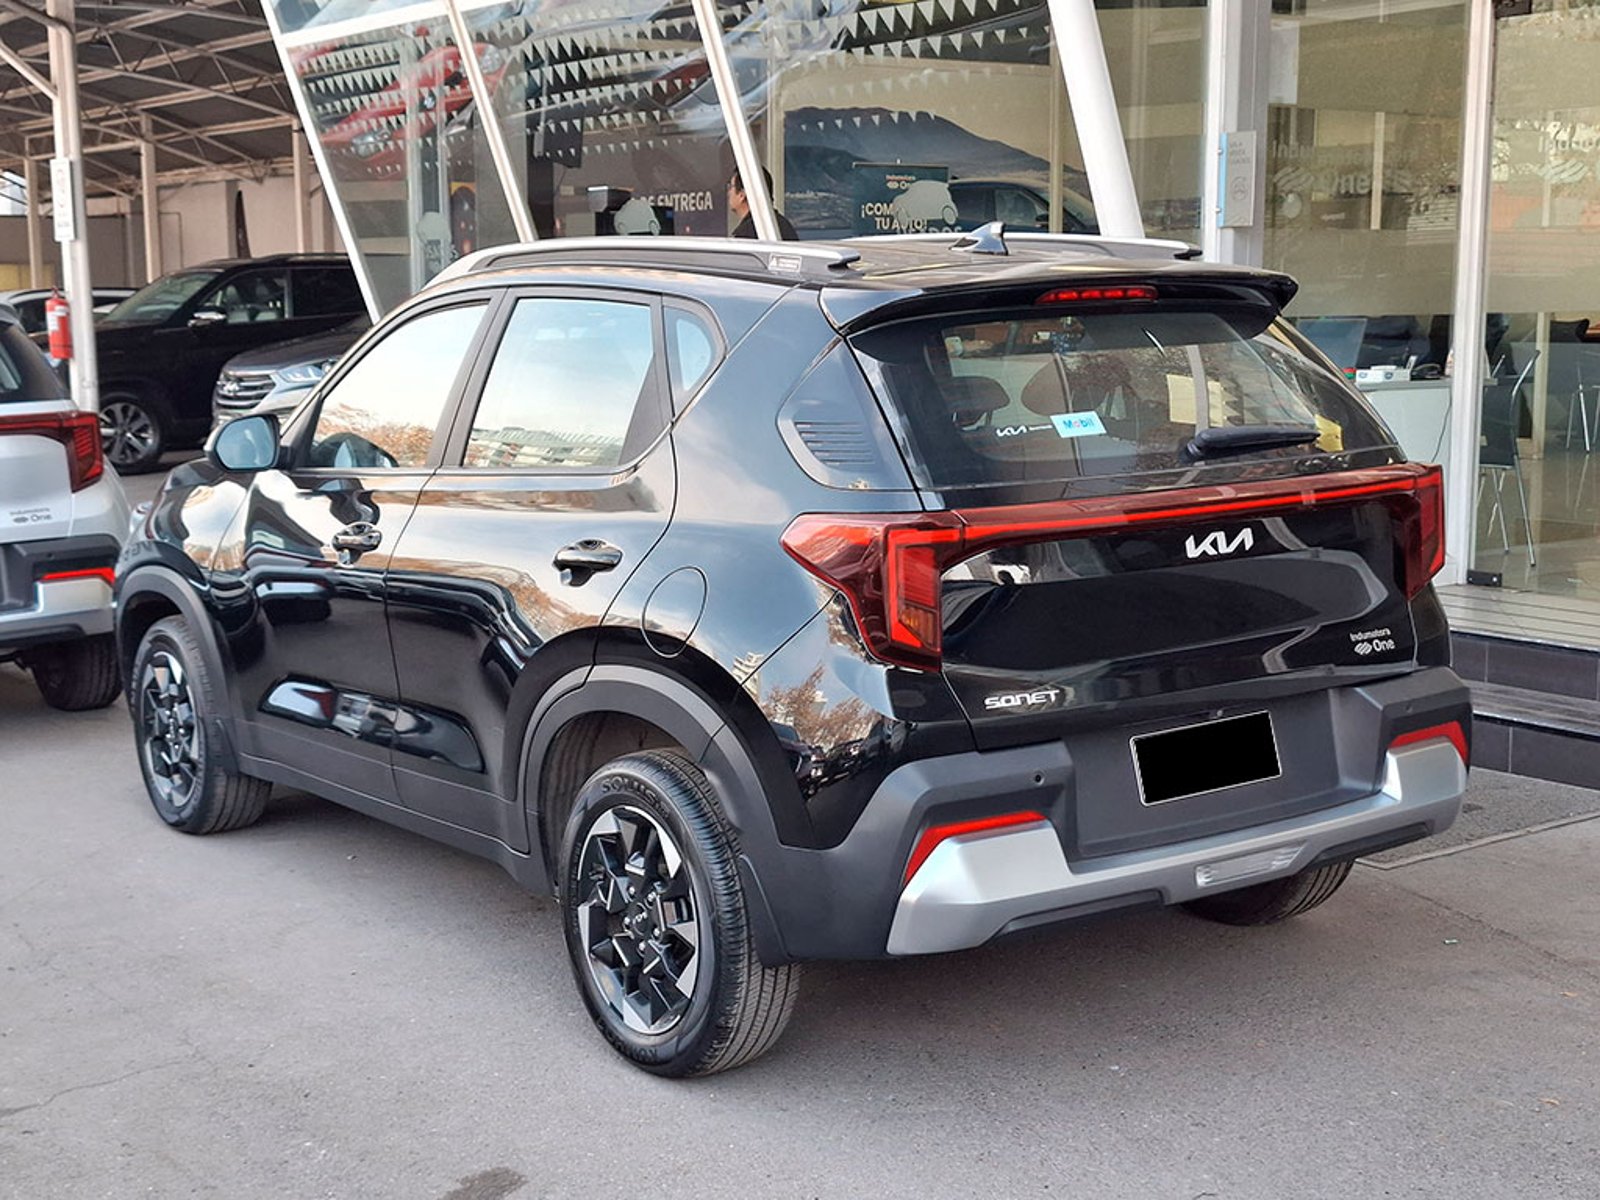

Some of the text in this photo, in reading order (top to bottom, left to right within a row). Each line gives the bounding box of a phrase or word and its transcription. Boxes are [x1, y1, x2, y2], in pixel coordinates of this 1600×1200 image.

[657, 191, 713, 211] ENTREGA
[1062, 417, 1097, 430] Mobil
[1185, 527, 1254, 559] KIA
[1372, 638, 1396, 652] One
[984, 689, 1060, 710] SONET
